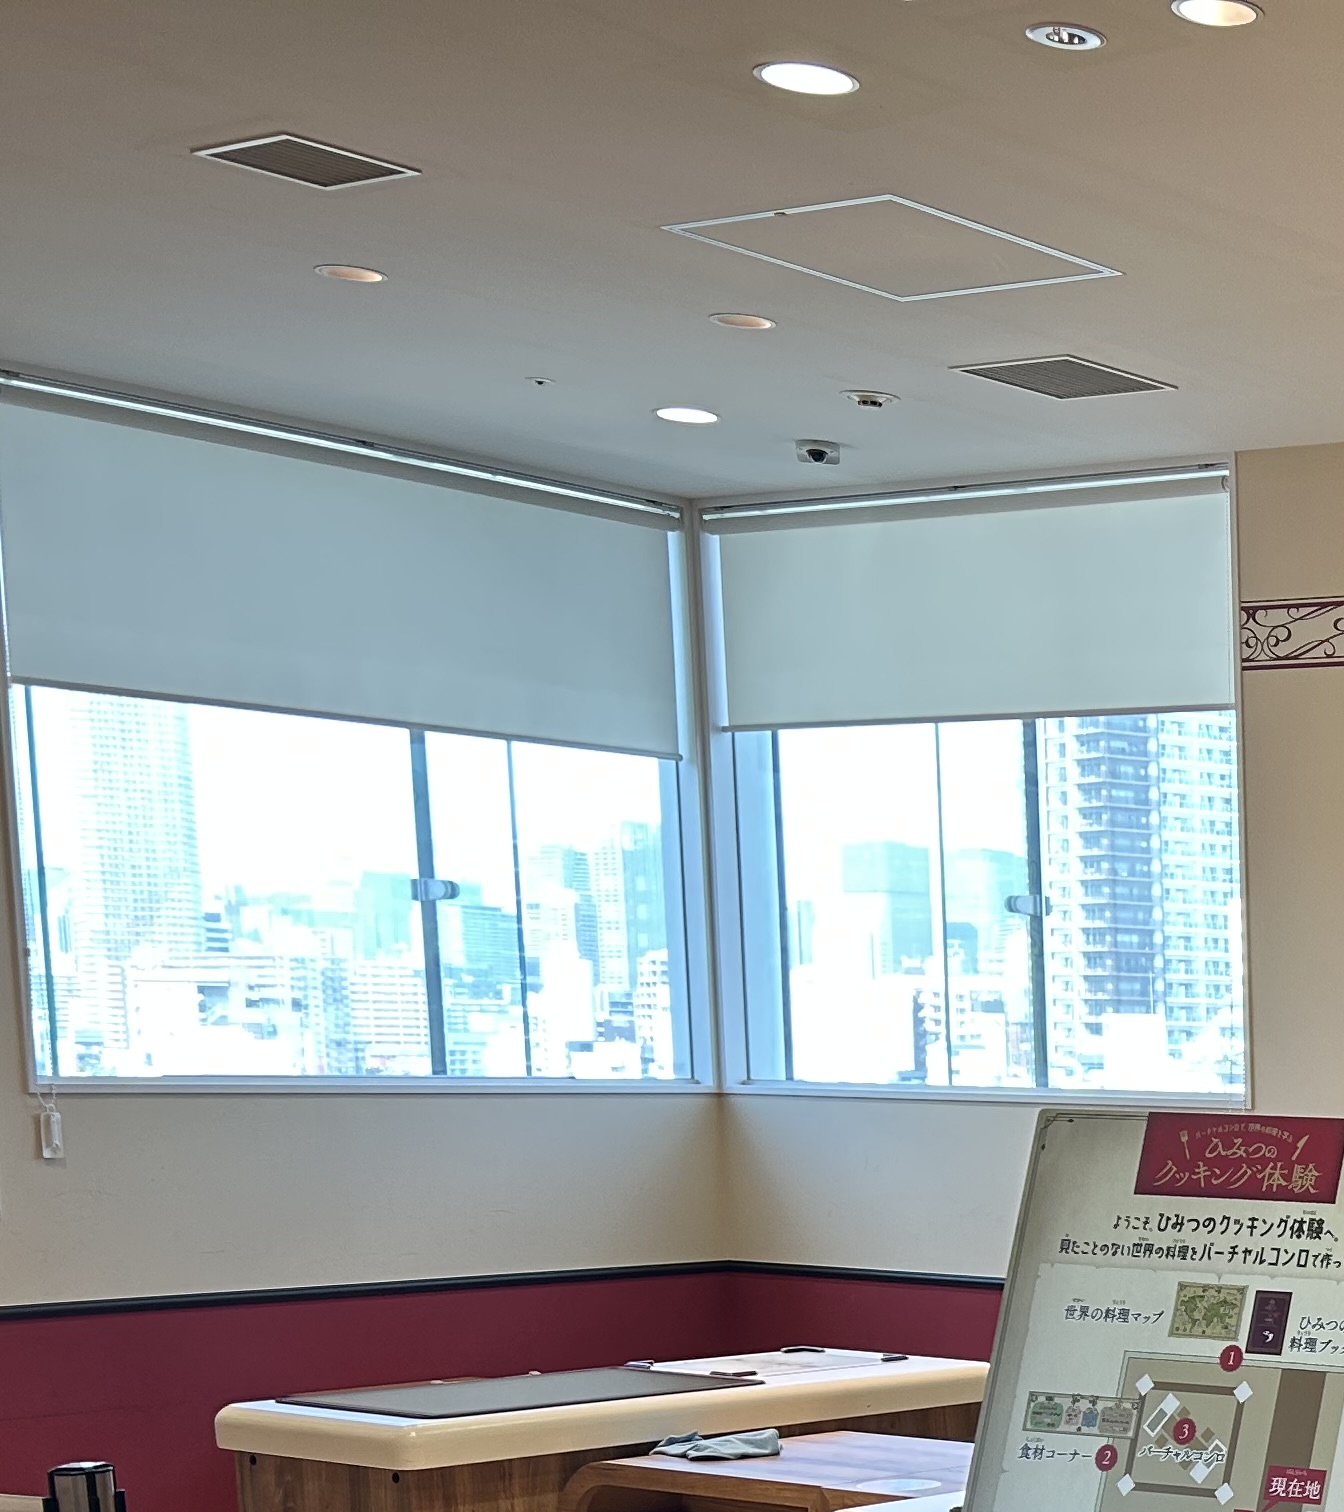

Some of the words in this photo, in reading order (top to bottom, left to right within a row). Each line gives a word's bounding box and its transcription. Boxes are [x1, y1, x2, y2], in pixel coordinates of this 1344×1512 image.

[1204, 1136, 1278, 1160] ひみつの
[1152, 1160, 1323, 1195] クッキング体験
[1063, 1304, 1165, 1326] 世界の料理マップ
[1017, 1443, 1093, 1461] 食材コーナー
[1138, 1445, 1227, 1465] バーチャルコンロ
[1268, 1476, 1323, 1501] 現在地
